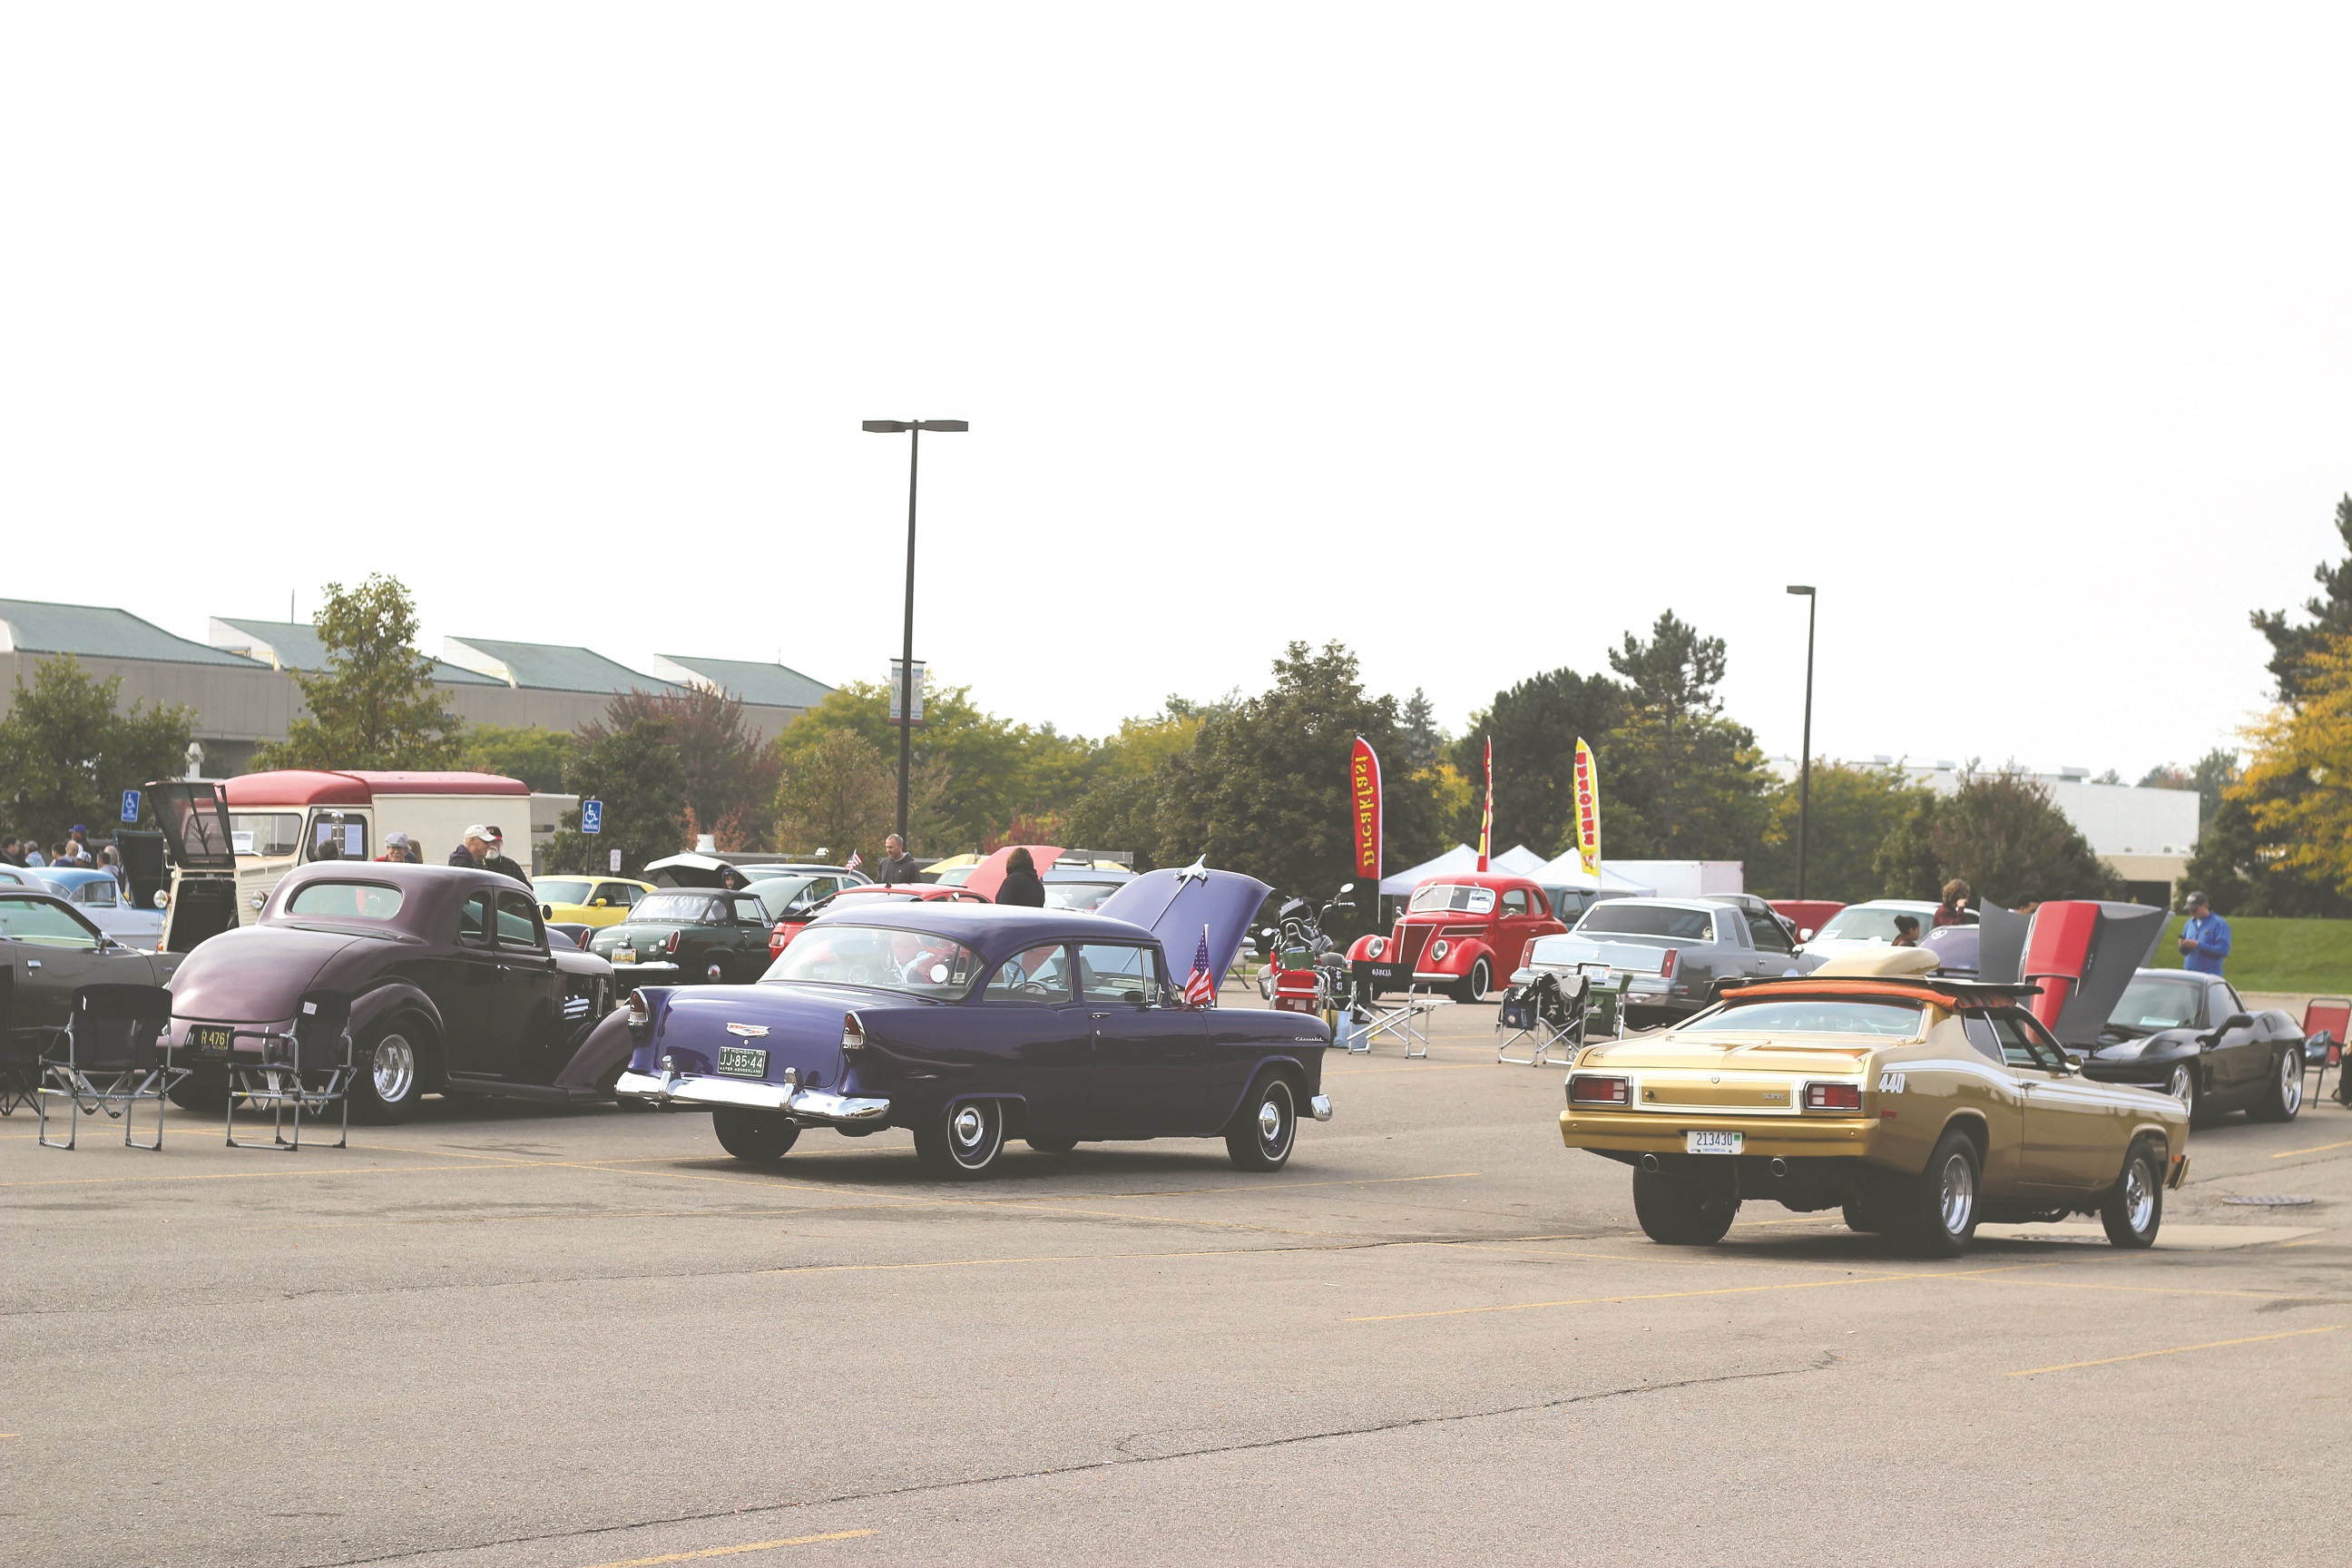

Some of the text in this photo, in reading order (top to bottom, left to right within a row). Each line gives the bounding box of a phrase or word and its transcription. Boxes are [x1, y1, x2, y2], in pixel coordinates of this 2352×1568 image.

[201, 1031, 208, 1044] R
[1878, 1073, 1906, 1093] 440
[1696, 1132, 1733, 1146] 213430
